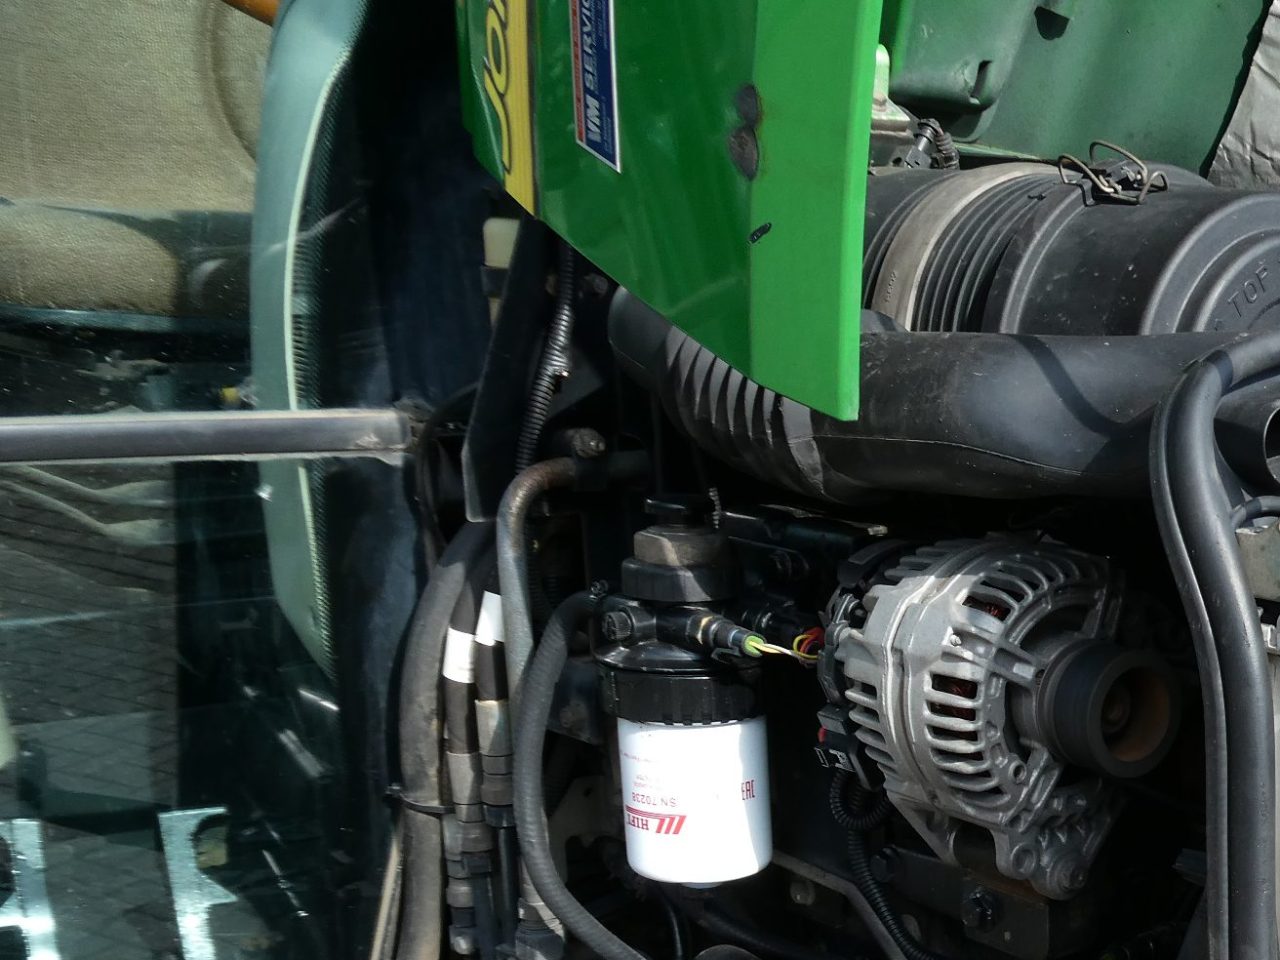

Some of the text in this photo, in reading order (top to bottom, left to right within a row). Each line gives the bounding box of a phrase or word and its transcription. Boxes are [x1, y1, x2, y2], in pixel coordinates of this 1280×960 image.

[485, 0, 511, 174] JO
[1227, 263, 1269, 318] TOP
[631, 791, 678, 808] SN 70238
